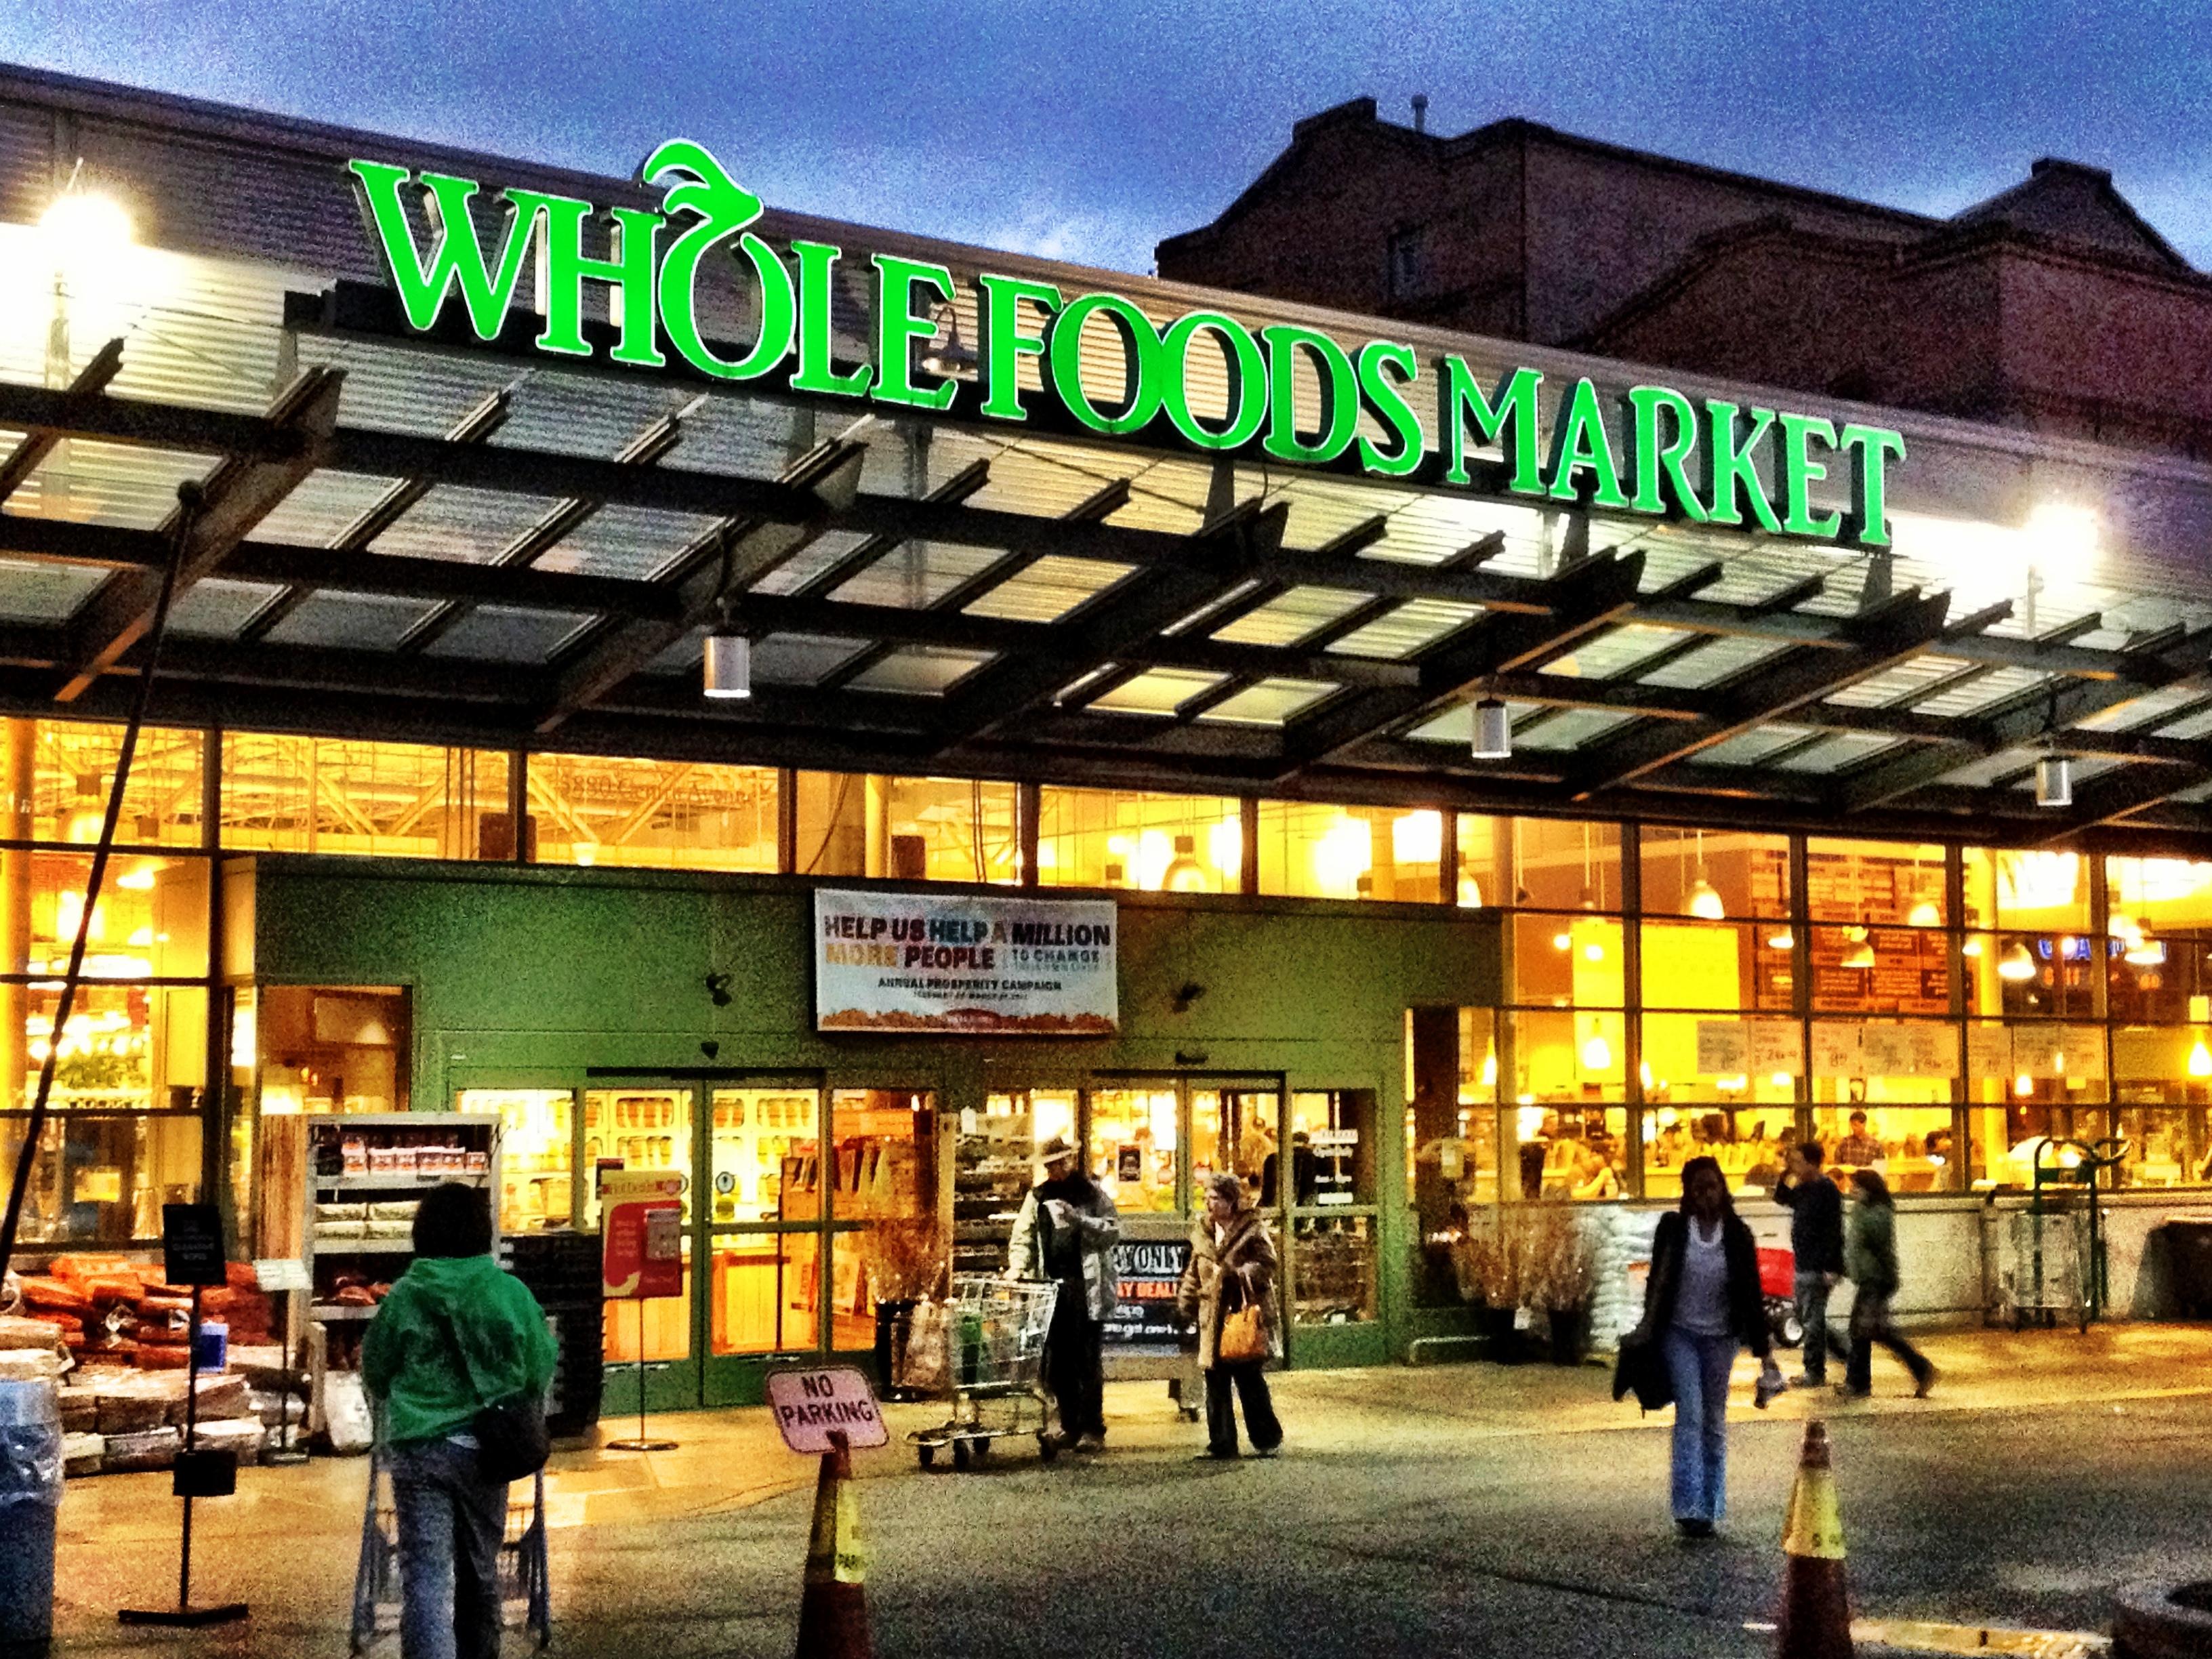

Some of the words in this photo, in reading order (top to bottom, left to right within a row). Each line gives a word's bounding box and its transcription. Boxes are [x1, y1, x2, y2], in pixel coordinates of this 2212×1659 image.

[349, 138, 958, 411] WHOLE
[978, 272, 1425, 476] FOODS
[1442, 352, 1906, 545] MARKET
[824, 915, 887, 940] HELP
[893, 918, 925, 941] US
[929, 919, 988, 943] HELP
[992, 920, 1007, 943] A
[1012, 922, 1110, 946] MILLION
[905, 945, 995, 969] PEOPLE
[1002, 979, 1062, 991] CAMPAIGN
[1134, 1246, 1183, 1273] ONLY
[802, 1374, 834, 1397] NO
[780, 1400, 874, 1427] PARKING
